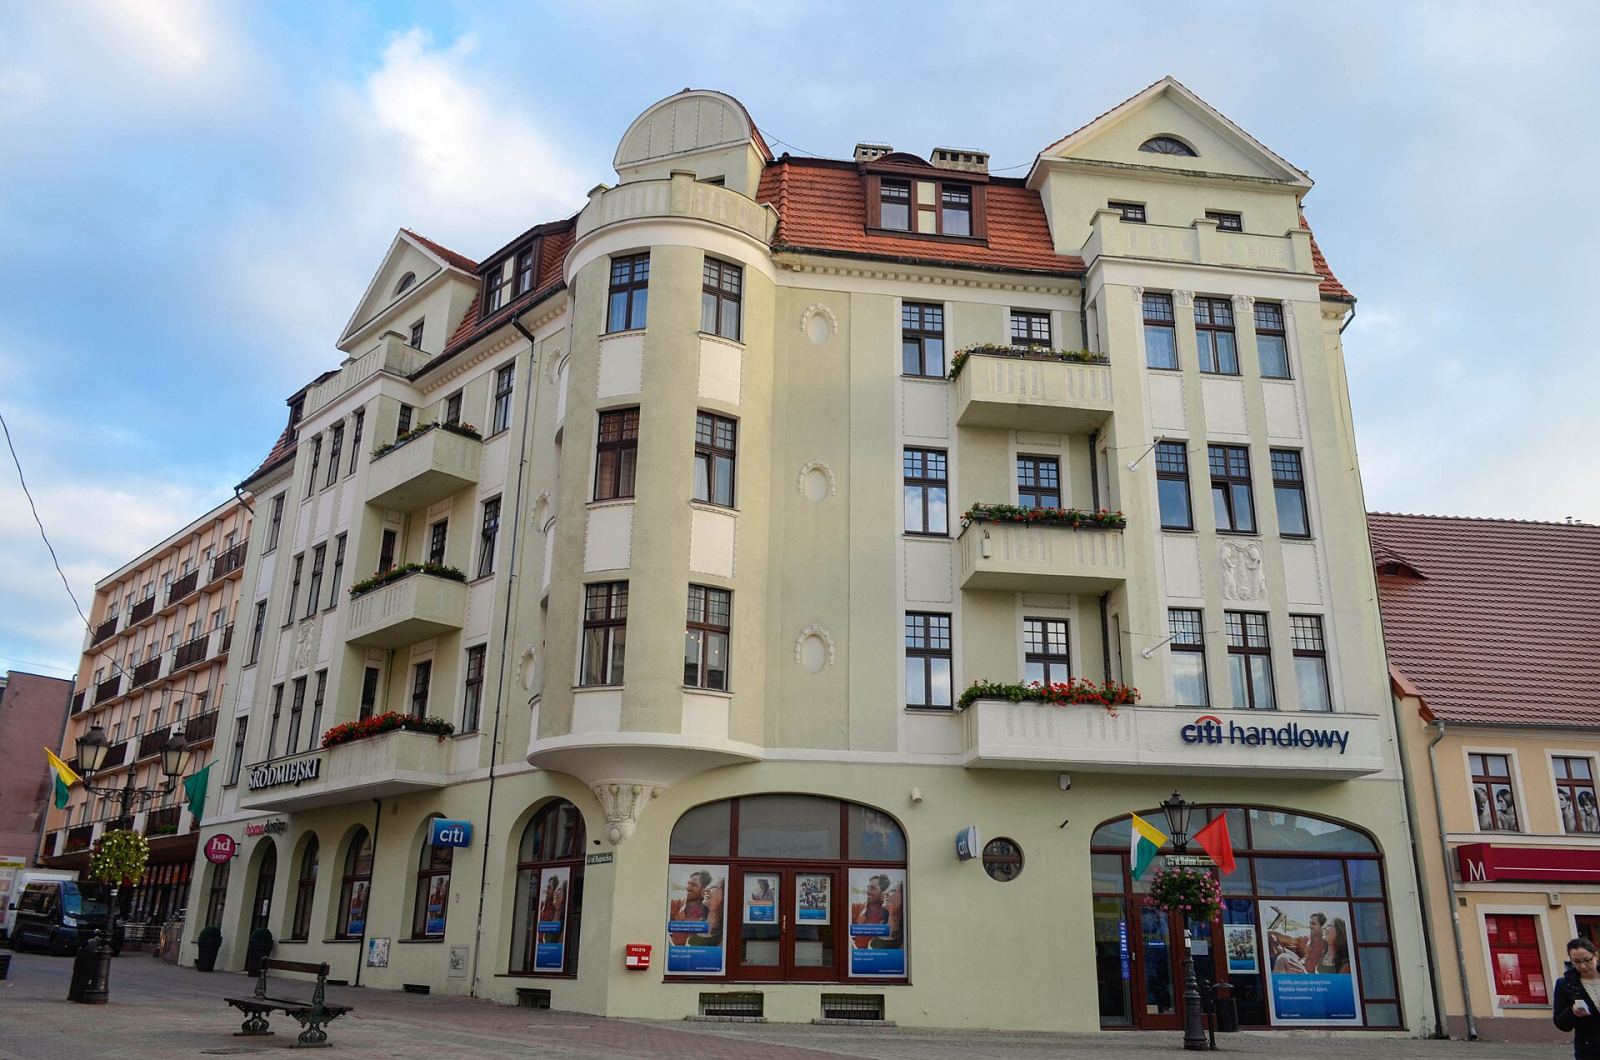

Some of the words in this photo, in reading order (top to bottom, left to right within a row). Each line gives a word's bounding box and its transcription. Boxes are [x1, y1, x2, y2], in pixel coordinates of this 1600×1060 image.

[1181, 717, 1223, 745] citi
[1229, 720, 1350, 755] handlowy
[440, 826, 464, 843] citi
[212, 838, 231, 851] hd
[1467, 859, 1486, 881] M
